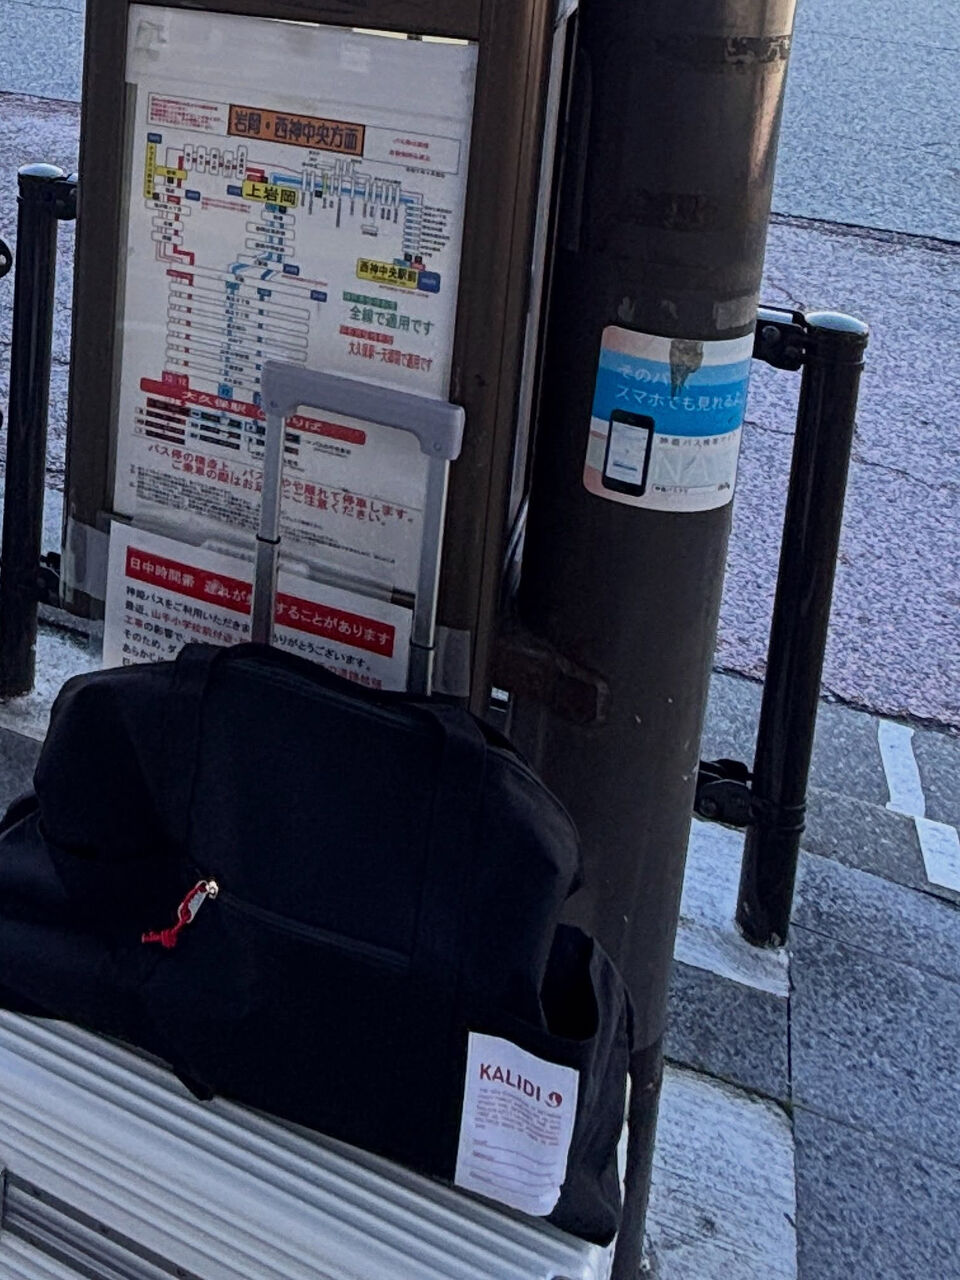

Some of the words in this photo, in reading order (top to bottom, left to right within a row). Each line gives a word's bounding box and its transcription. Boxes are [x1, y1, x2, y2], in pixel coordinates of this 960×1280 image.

[234, 109, 360, 152] 岩岡・西神中央方面
[245, 182, 297, 207] 上岩岡
[359, 260, 418, 283] 西神中央駅前
[181, 390, 247, 415] 大久保駅
[479, 1062, 541, 1103] KALIDI
